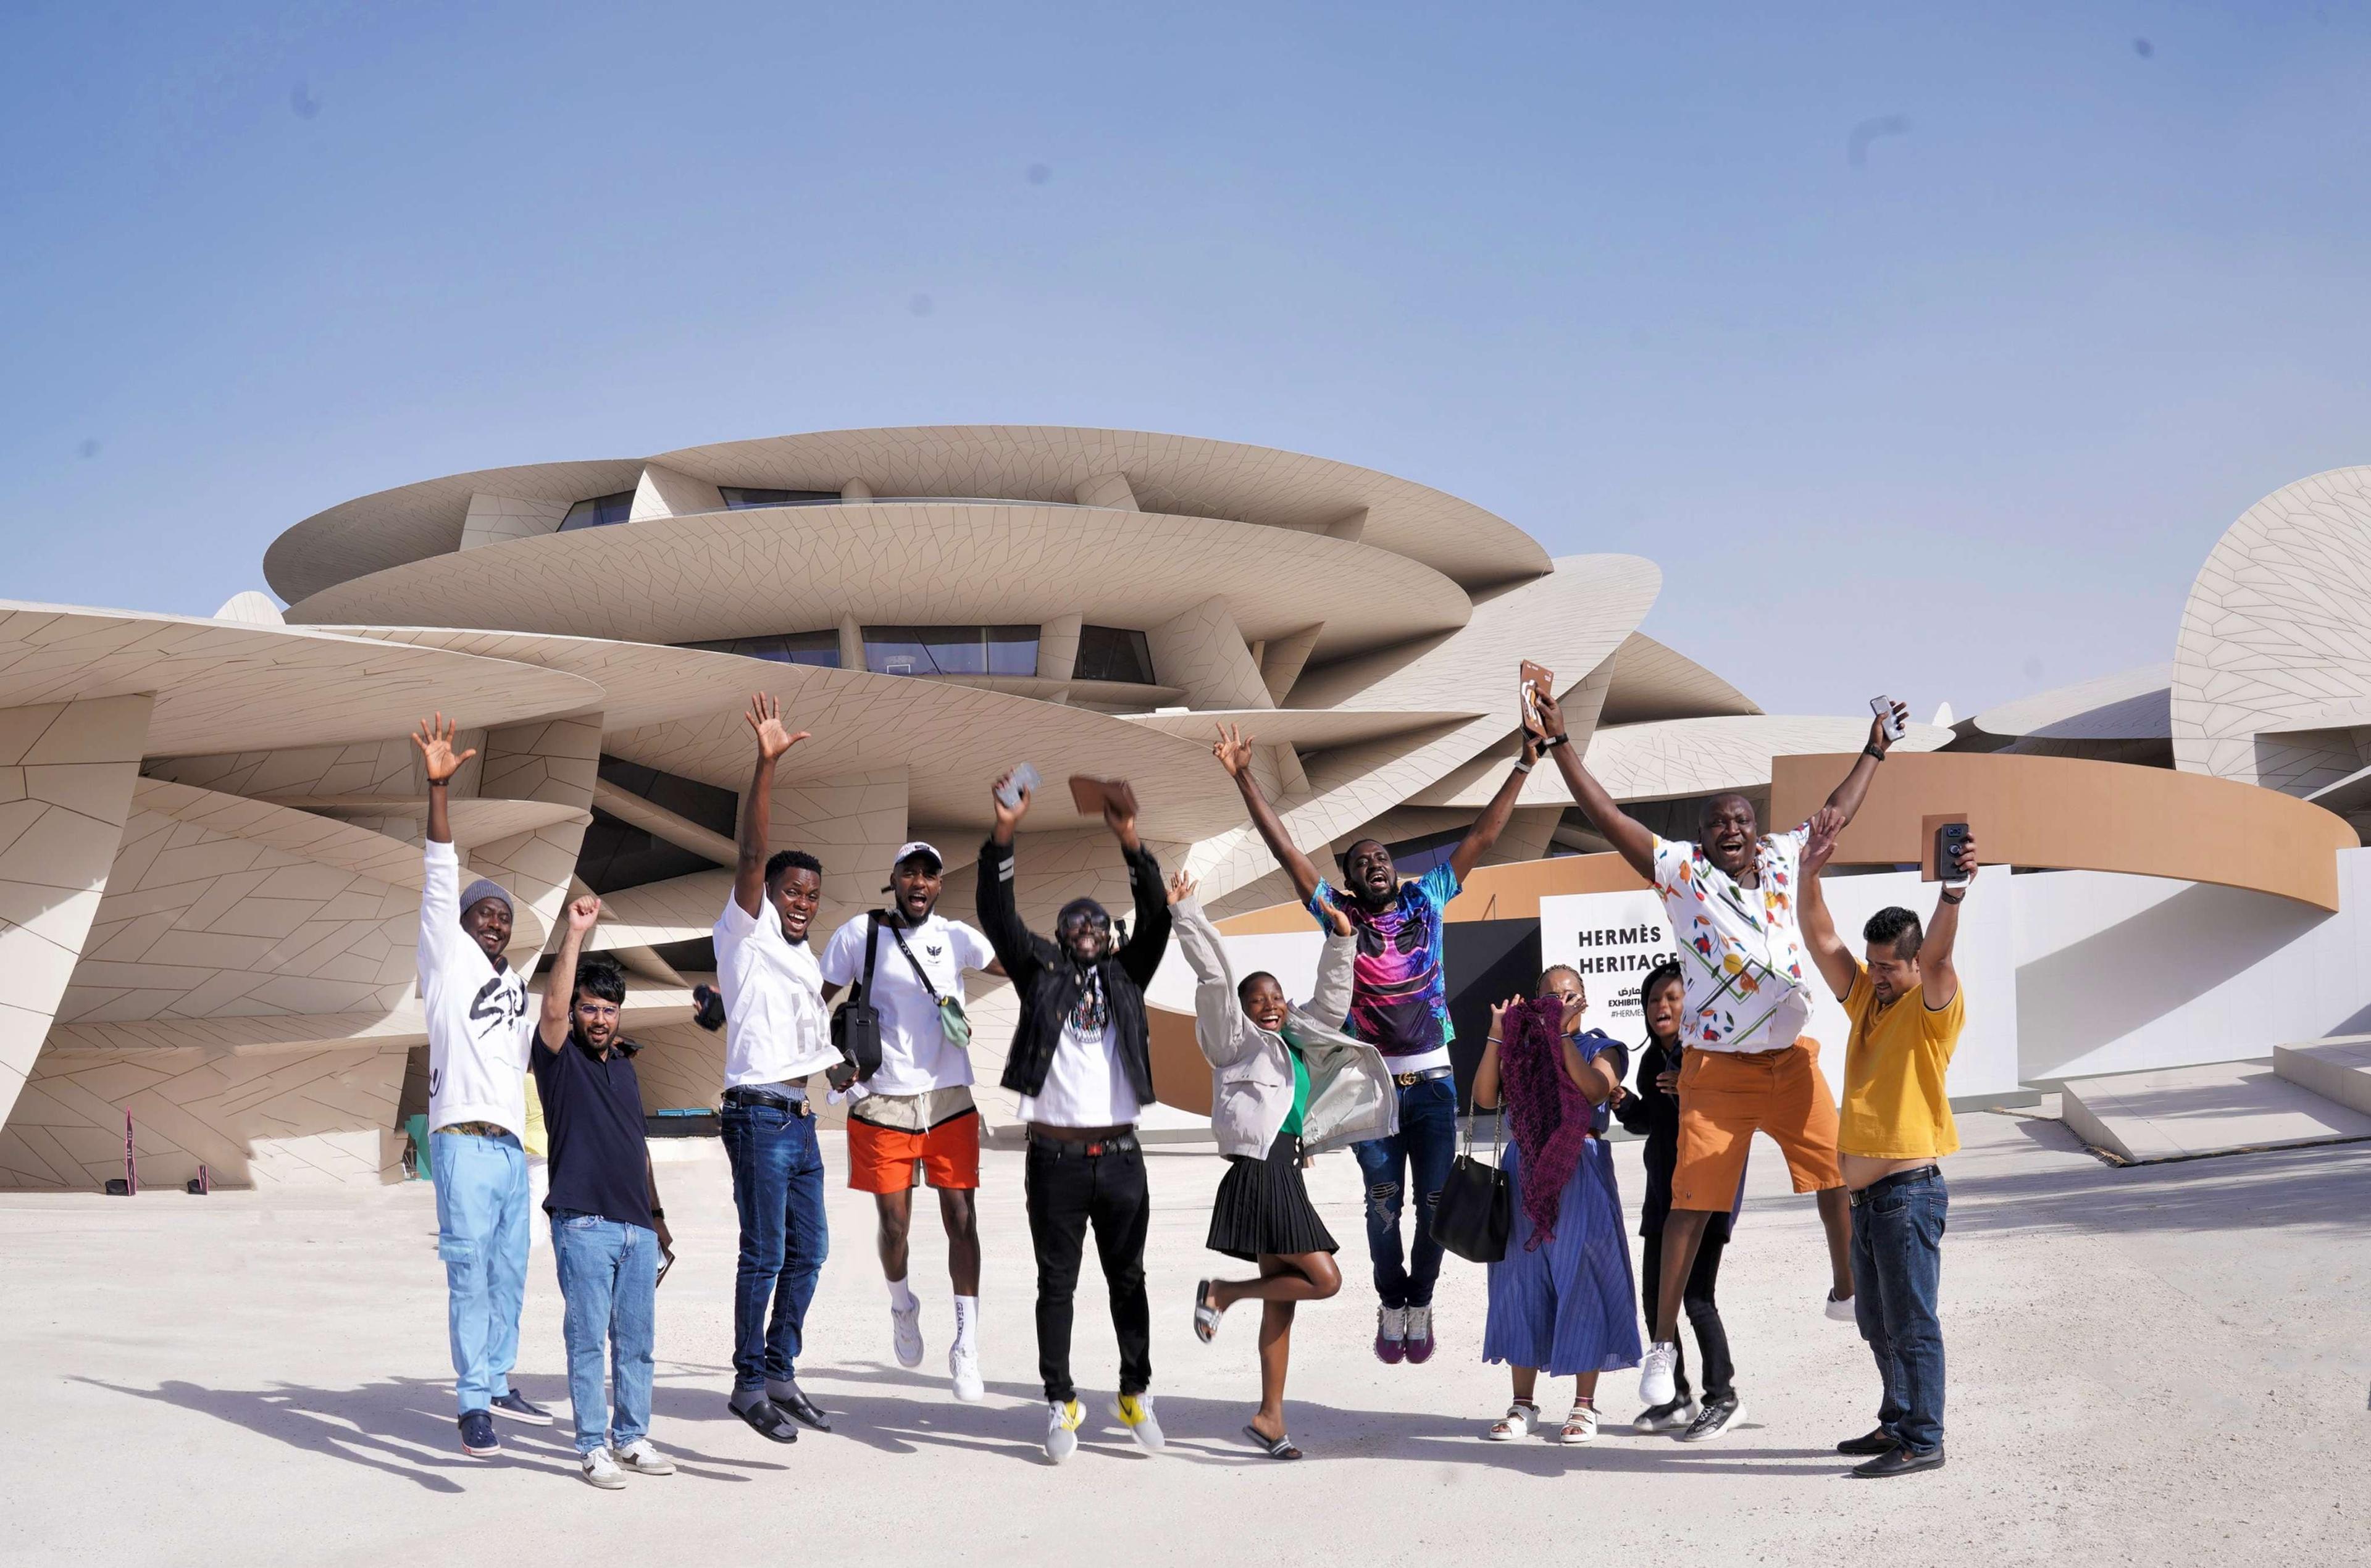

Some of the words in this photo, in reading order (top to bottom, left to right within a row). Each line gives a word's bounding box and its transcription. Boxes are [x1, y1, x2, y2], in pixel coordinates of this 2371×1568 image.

[1578, 924, 1661, 948] HERMÈS
[1579, 952, 1678, 974] HERITAGE
[1618, 987, 1642, 997] عارض
[1608, 998, 1641, 1007] EXHIBITI
